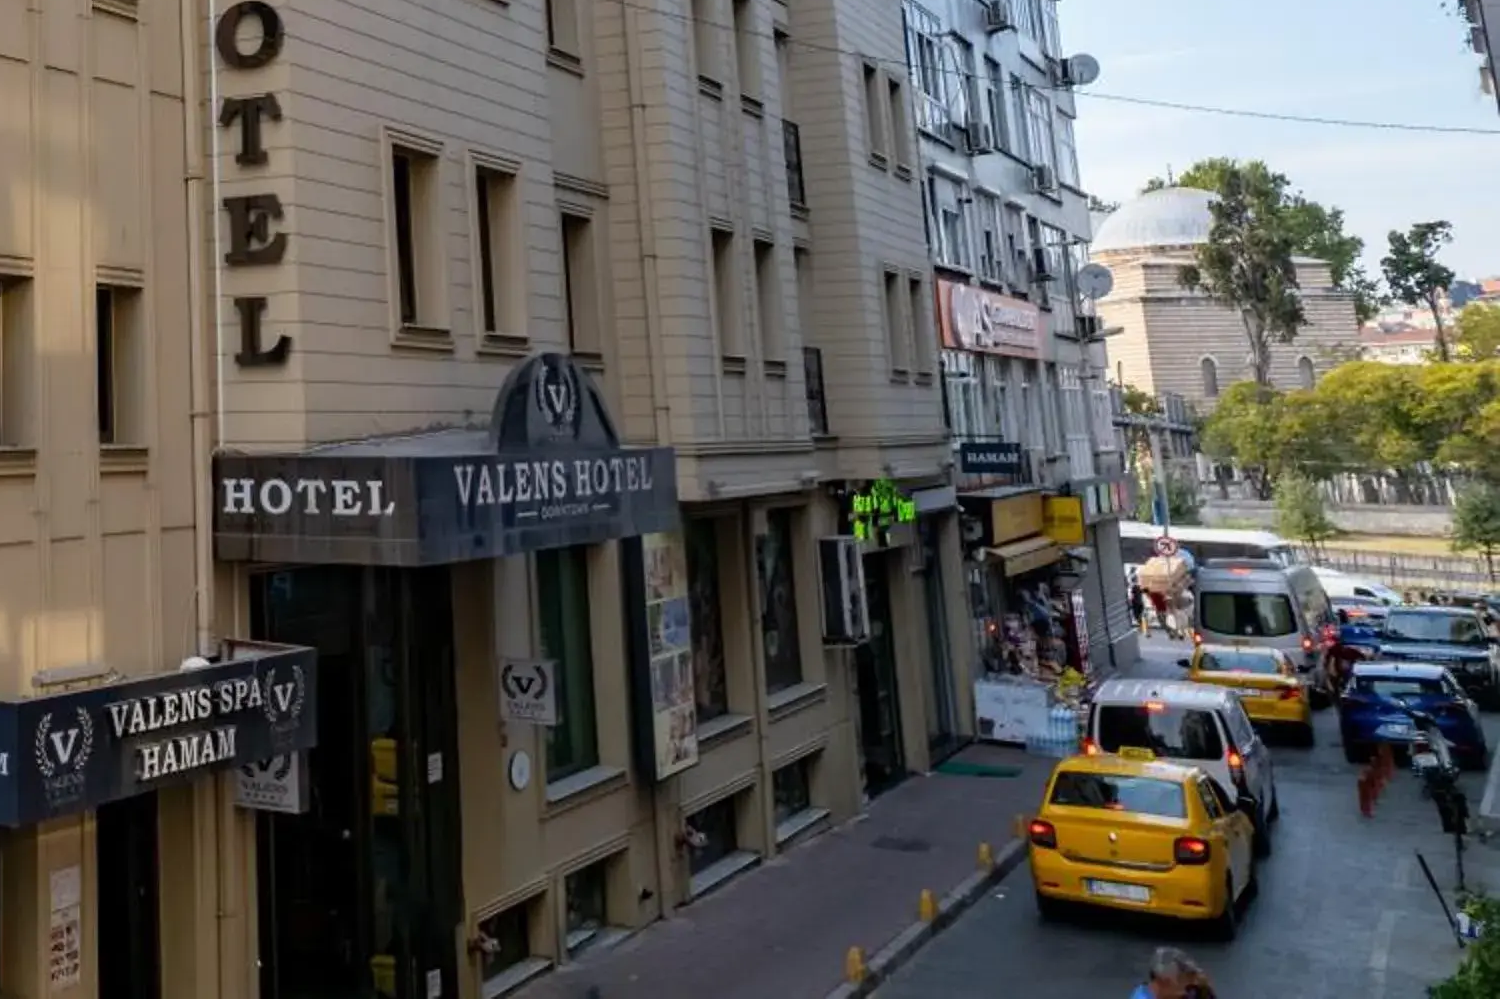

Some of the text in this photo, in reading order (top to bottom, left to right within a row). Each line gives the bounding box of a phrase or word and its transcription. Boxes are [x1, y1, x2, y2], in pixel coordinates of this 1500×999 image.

[549, 385, 566, 414] V
[222, 478, 396, 517] HOTEL
[453, 456, 653, 506] VALENS HOTEL
[110, 678, 263, 739] VALENS SPA
[274, 682, 295, 712] V
[50, 729, 79, 764] V
[140, 728, 237, 781] HAMAM
